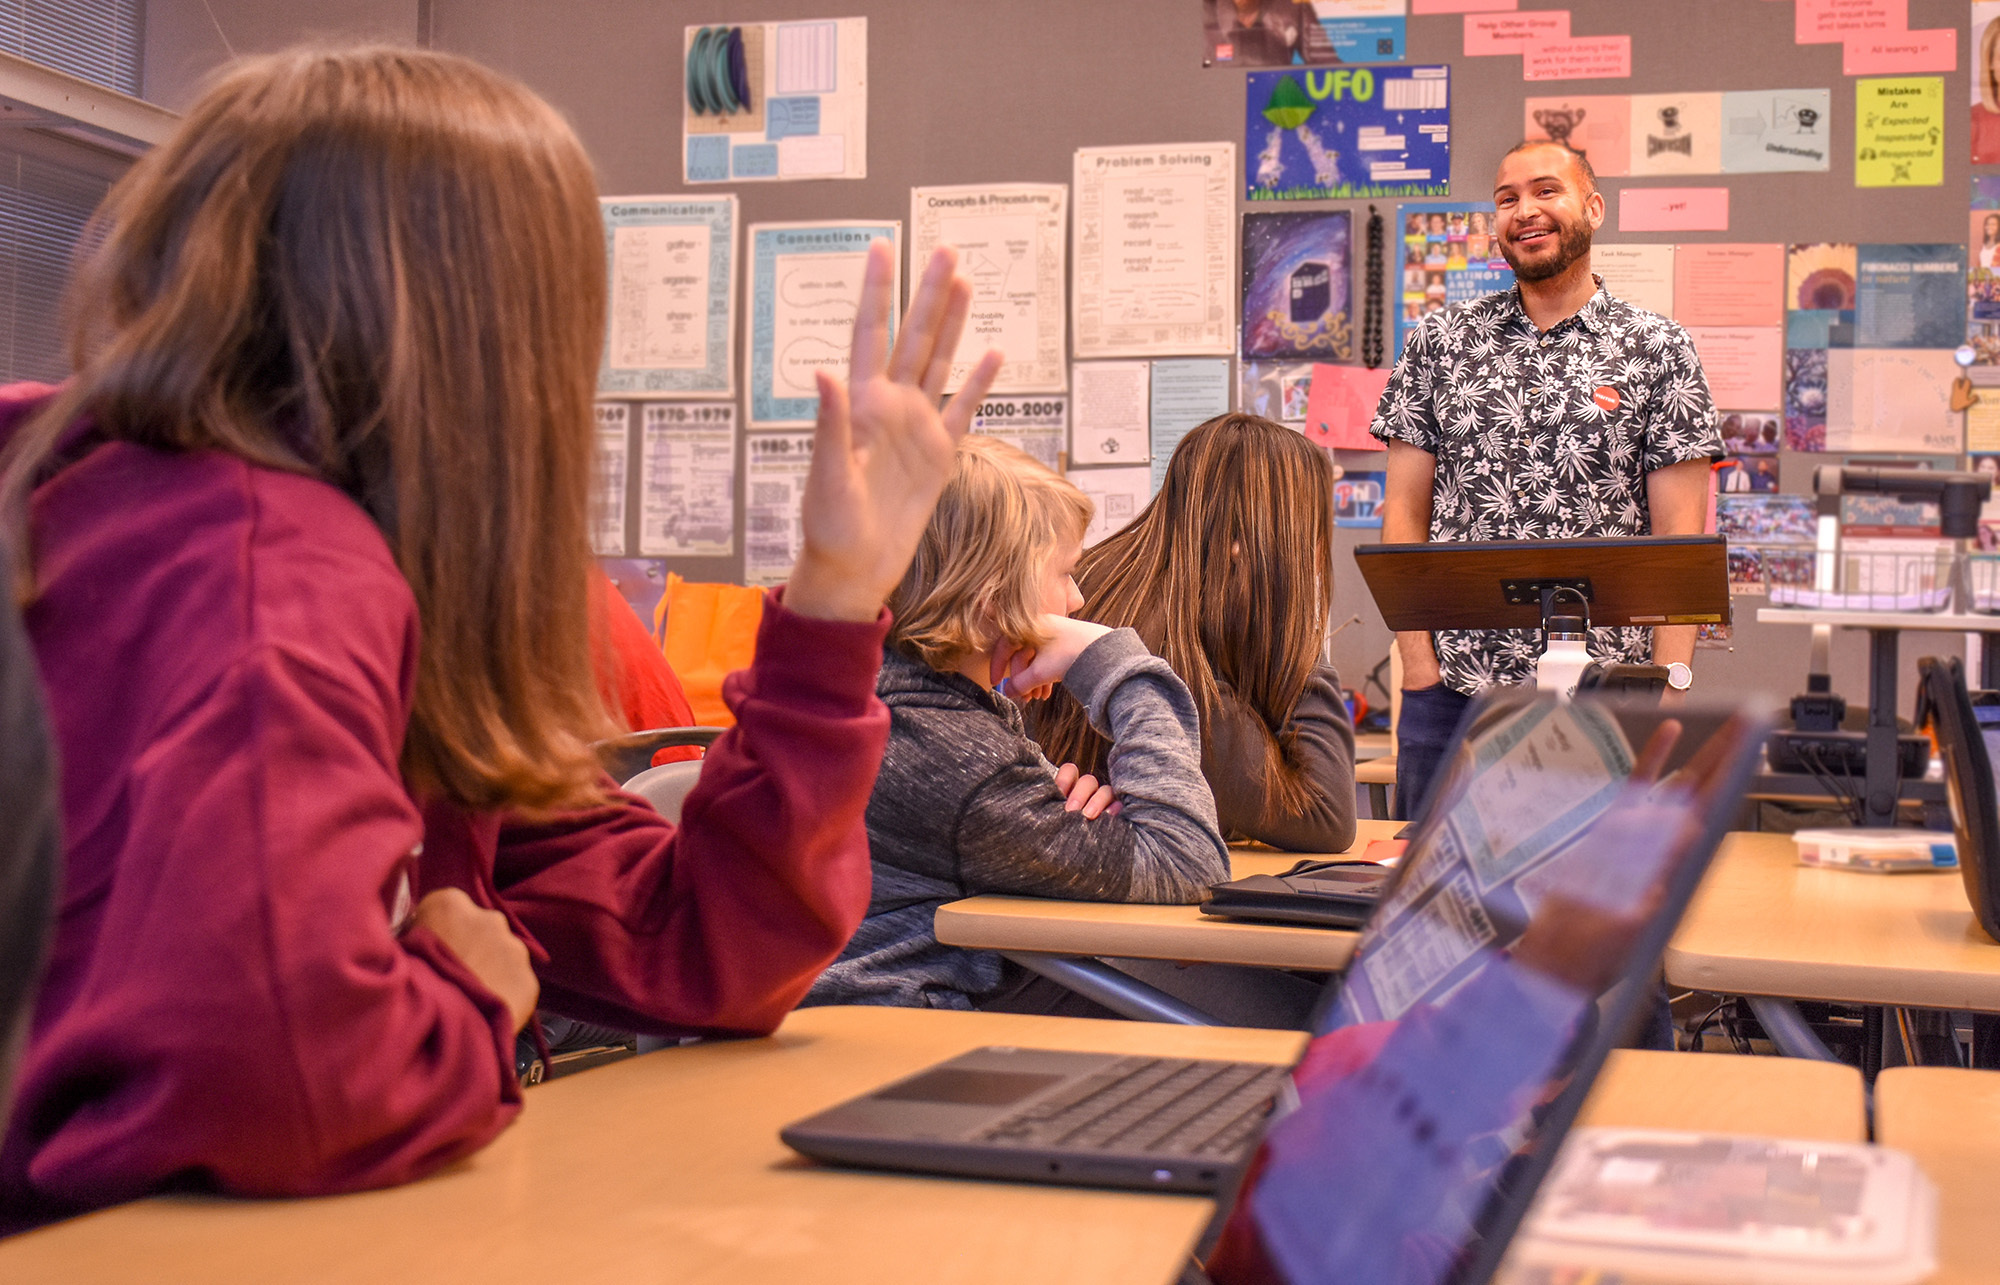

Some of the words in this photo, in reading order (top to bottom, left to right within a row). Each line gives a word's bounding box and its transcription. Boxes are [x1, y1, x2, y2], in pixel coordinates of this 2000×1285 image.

[1839, 10, 1864, 19] equal
[1477, 22, 1497, 31] Help
[1500, 20, 1525, 29] Other
[1528, 19, 1557, 29] Group
[1817, 22, 1834, 30] and
[1863, 20, 1886, 28] turns
[1575, 44, 1599, 53] doing
[1871, 45, 1882, 53] All
[1569, 55, 1590, 63] them
[1604, 55, 1622, 64] only
[1533, 69, 1559, 77] giving
[1585, 66, 1621, 74] answers
[1305, 69, 1374, 102] UFO
[1877, 86, 1922, 96] Mistakes
[1890, 100, 1908, 108] Are
[1881, 116, 1930, 126] Expected
[1874, 133, 1926, 143] Inspected
[1766, 142, 1824, 162] Understanding
[1879, 149, 1934, 159] Respected
[1096, 156, 1155, 168] Problem
[1159, 154, 1212, 167] Solving
[928, 197, 977, 208] Concepts
[978, 196, 987, 206] &
[989, 194, 1051, 206] Procedures
[611, 204, 716, 217] Communication
[777, 231, 873, 245] Connections
[1123, 238, 1152, 247] record
[1861, 262, 1911, 273] FIBONACCI
[1912, 262, 1959, 273] NUMBERS
[1862, 275, 1872, 284] in
[1876, 275, 1911, 284] nature
[1448, 281, 1475, 289] AND
[971, 312, 1005, 320] Probability
[788, 318, 797, 326] to
[799, 318, 820, 326] other
[789, 357, 800, 365] for
[802, 357, 839, 366] everyday
[648, 407, 731, 422] 1970-1979
[976, 402, 1063, 417] 2000-2009
